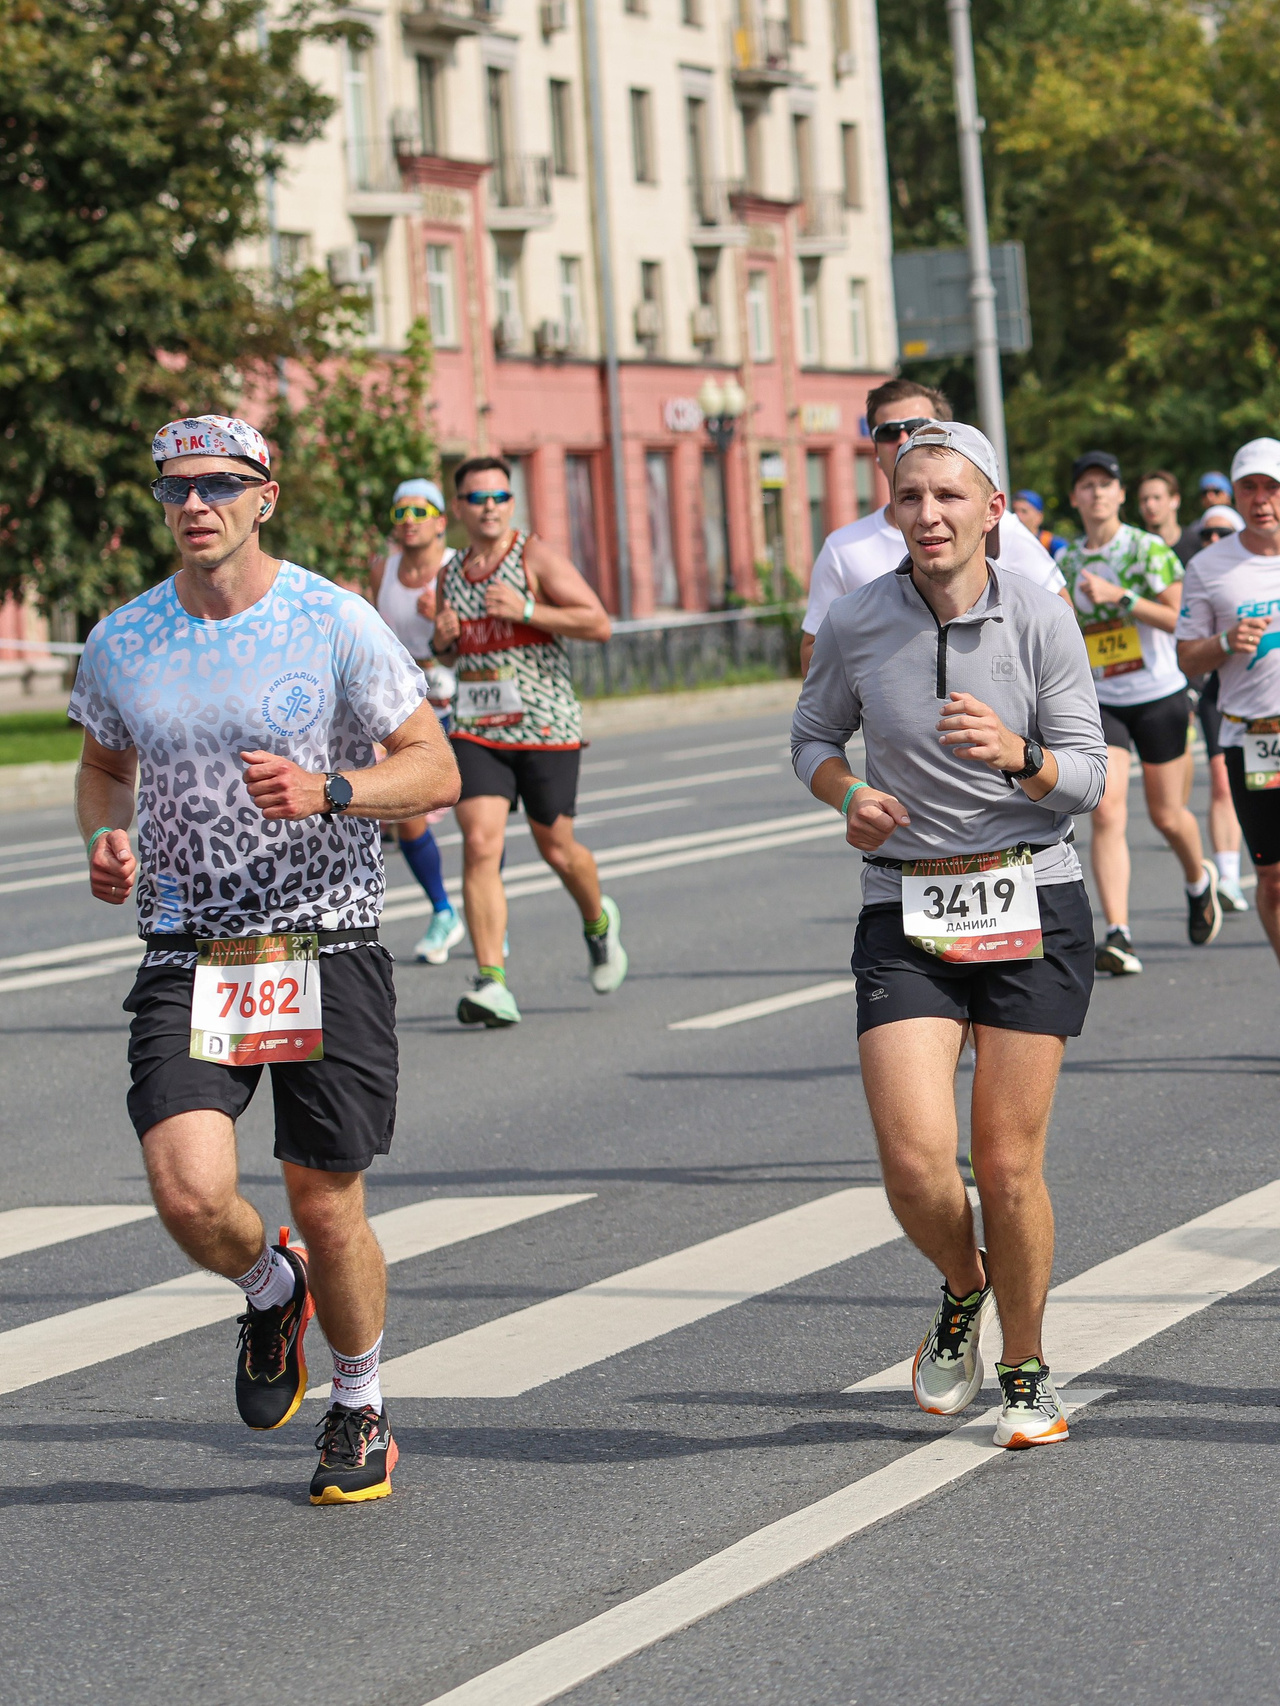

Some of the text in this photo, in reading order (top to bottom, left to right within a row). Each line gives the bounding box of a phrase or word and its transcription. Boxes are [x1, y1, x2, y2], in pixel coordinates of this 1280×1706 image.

[175, 434, 211, 454] PEACE
[1098, 633, 1128, 654] 474
[995, 661, 1014, 675] IQ
[468, 686, 500, 704] 999
[923, 878, 1016, 920] 3419
[946, 917, 997, 933] ДАНИИЛ
[217, 977, 300, 1018] 7682
[209, 1035, 223, 1055] D
